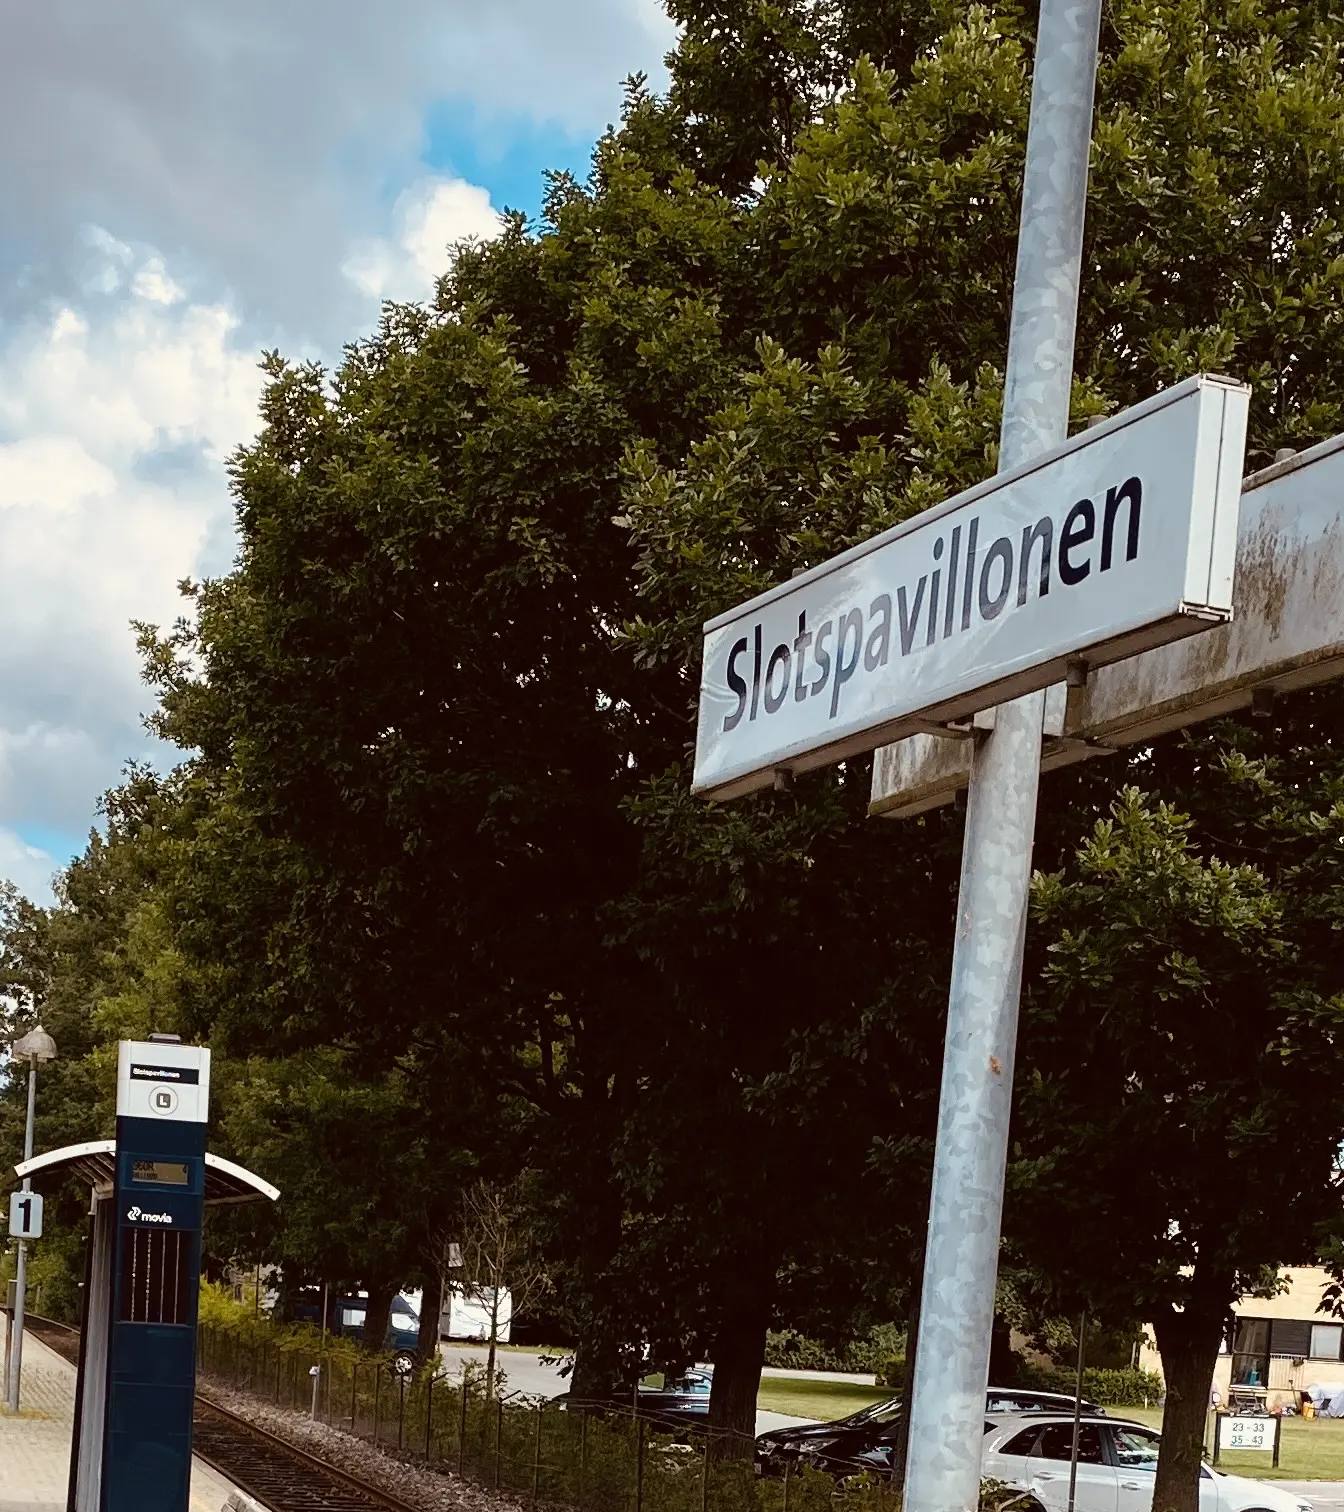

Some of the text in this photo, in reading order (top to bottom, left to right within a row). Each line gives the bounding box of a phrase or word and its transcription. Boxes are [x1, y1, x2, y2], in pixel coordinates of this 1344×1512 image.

[723, 475, 1143, 733] Slotspavillonen
[18, 1198, 32, 1233] 1
[1232, 1422, 1244, 1432] 23
[1252, 1423, 1265, 1433] 33
[1231, 1435, 1243, 1444] 35
[1251, 1435, 1264, 1445] 43
